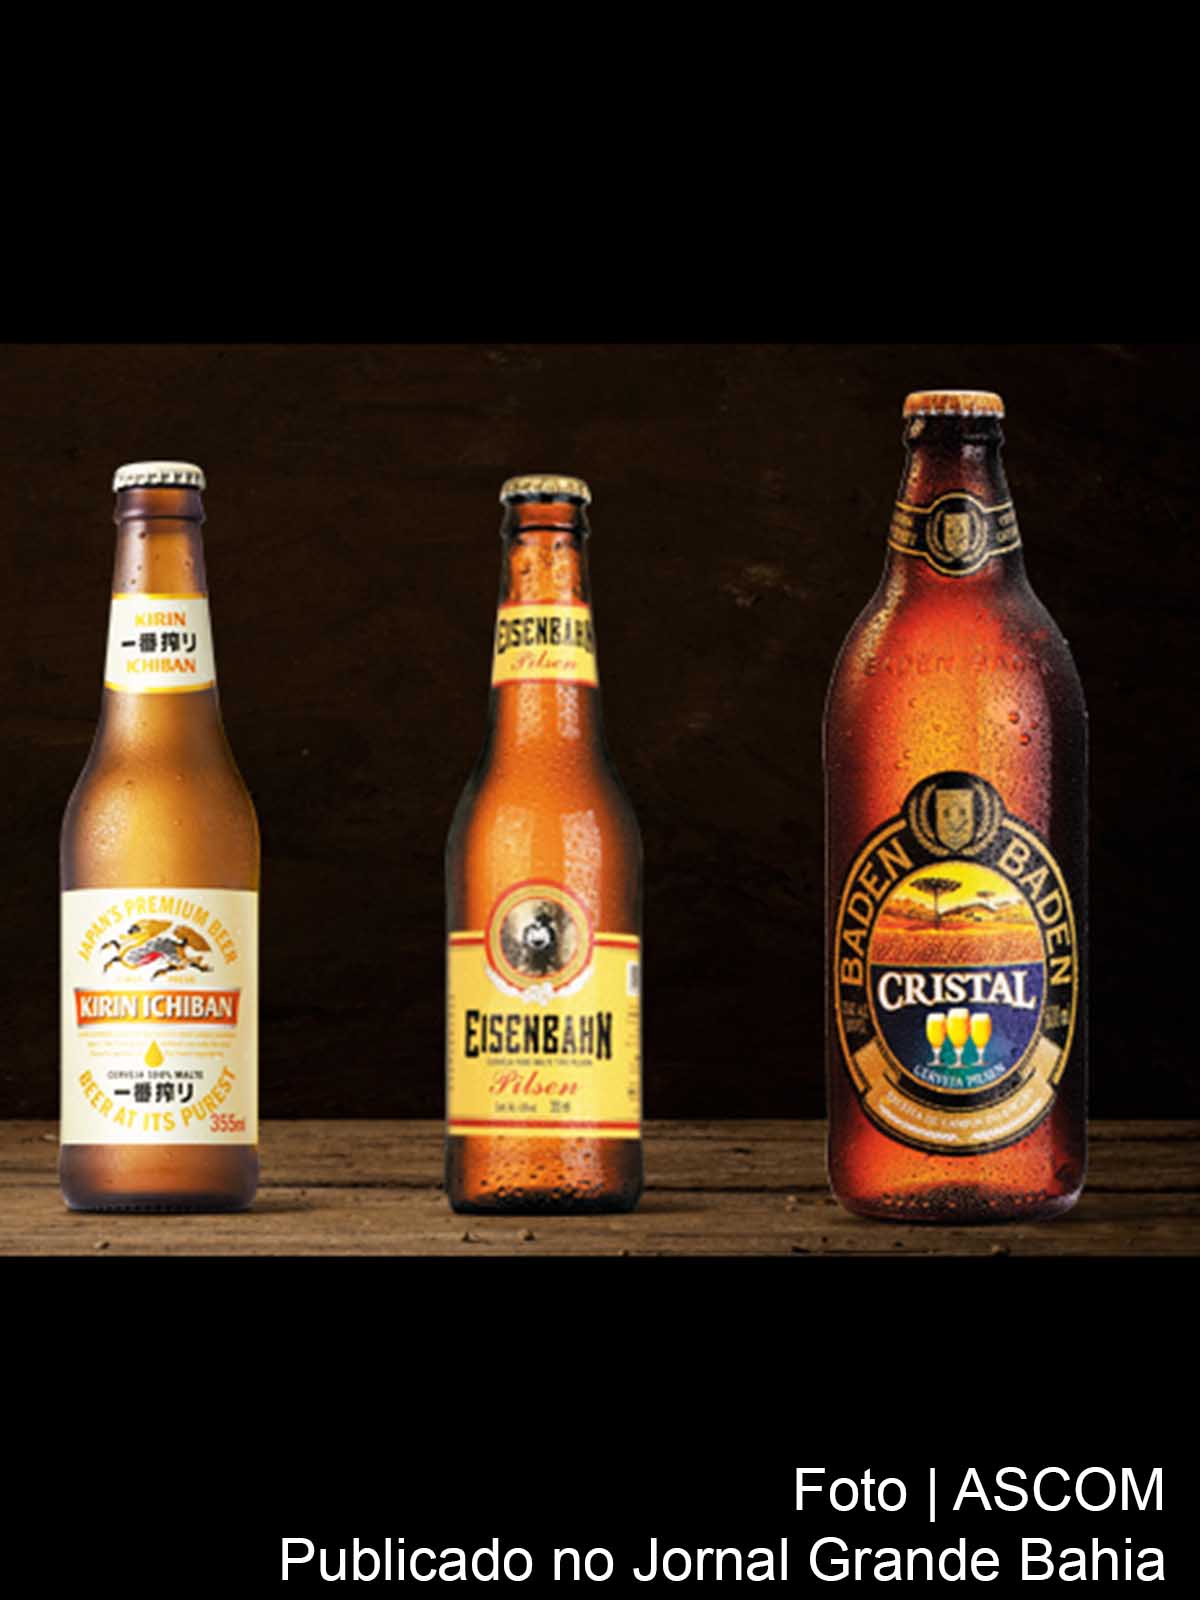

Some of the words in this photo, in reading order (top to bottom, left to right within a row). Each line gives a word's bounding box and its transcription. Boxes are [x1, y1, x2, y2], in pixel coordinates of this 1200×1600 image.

[135, 611, 187, 626] KIRIN
[121, 631, 197, 653] 一番搾り
[497, 616, 595, 654] EISENBAHN
[126, 657, 197, 673] ICHIBAN
[510, 650, 577, 672] Pilsen
[840, 836, 914, 987] BADEN
[998, 836, 1073, 985] BADEN
[125, 895, 211, 928] PREMIUM
[207, 917, 240, 965] BEER
[878, 970, 1038, 1011] CRISTAL
[80, 995, 138, 1018] KIRIN
[143, 995, 234, 1019] ICHIBAN
[464, 1009, 613, 1061] EISENBAHN
[488, 1071, 579, 1097] Pilsen
[913, 1064, 963, 1088] CERVEJA
[966, 1062, 1006, 1088] PILSEN
[78, 1069, 115, 1118] BEER
[113, 1104, 135, 1129] AT
[144, 1111, 177, 1133] ITS
[180, 1065, 238, 1128] PUREST
[113, 1081, 194, 1104] 一番搾り
